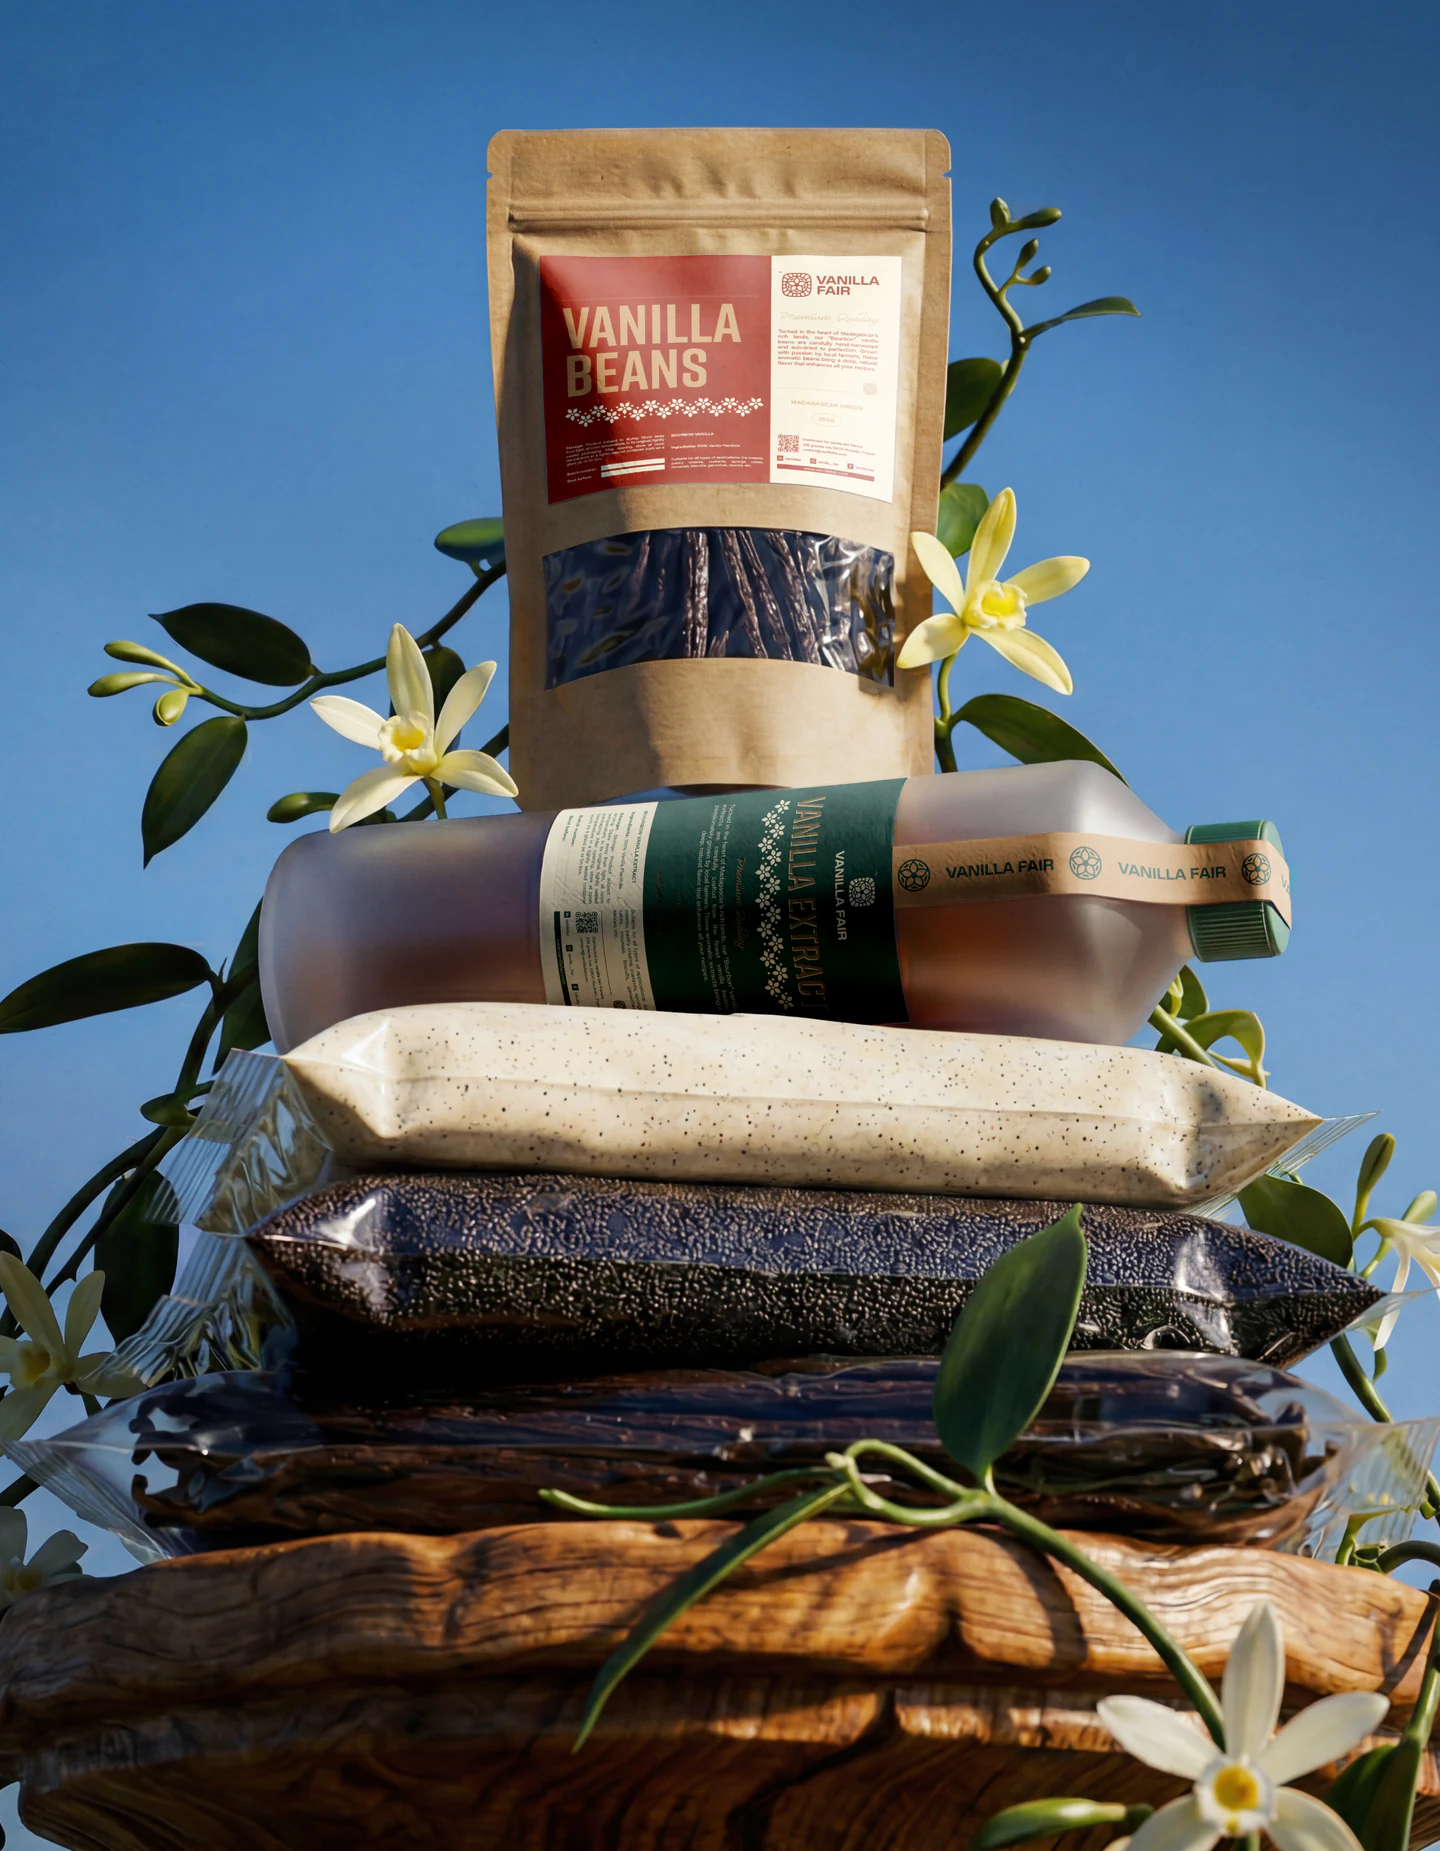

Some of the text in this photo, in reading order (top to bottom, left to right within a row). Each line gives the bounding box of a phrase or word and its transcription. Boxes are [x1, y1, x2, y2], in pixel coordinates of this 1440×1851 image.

[816, 276, 879, 285] VANILLA
[817, 286, 850, 295] FAIR
[563, 303, 741, 349] VANILLA
[780, 311, 879, 327] Premium Quality
[566, 348, 707, 398] BEANS
[791, 400, 838, 408] MADAGASCAR
[638, 811, 648, 835] BOURBON
[708, 805, 719, 839] passionately
[718, 804, 726, 826] extracts
[726, 804, 735, 823] Tucked
[625, 812, 636, 838] Ingredients:
[634, 836, 642, 858] VANILLA
[699, 831, 707, 846] deep,
[946, 859, 1054, 879] VANILLA FAIR
[1118, 861, 1226, 881] VANILLA FAIR
[788, 795, 832, 1012] VANILLA EXTRACT
[834, 850, 848, 941] VANILLA FAIR
[709, 962, 717, 988] extracts
